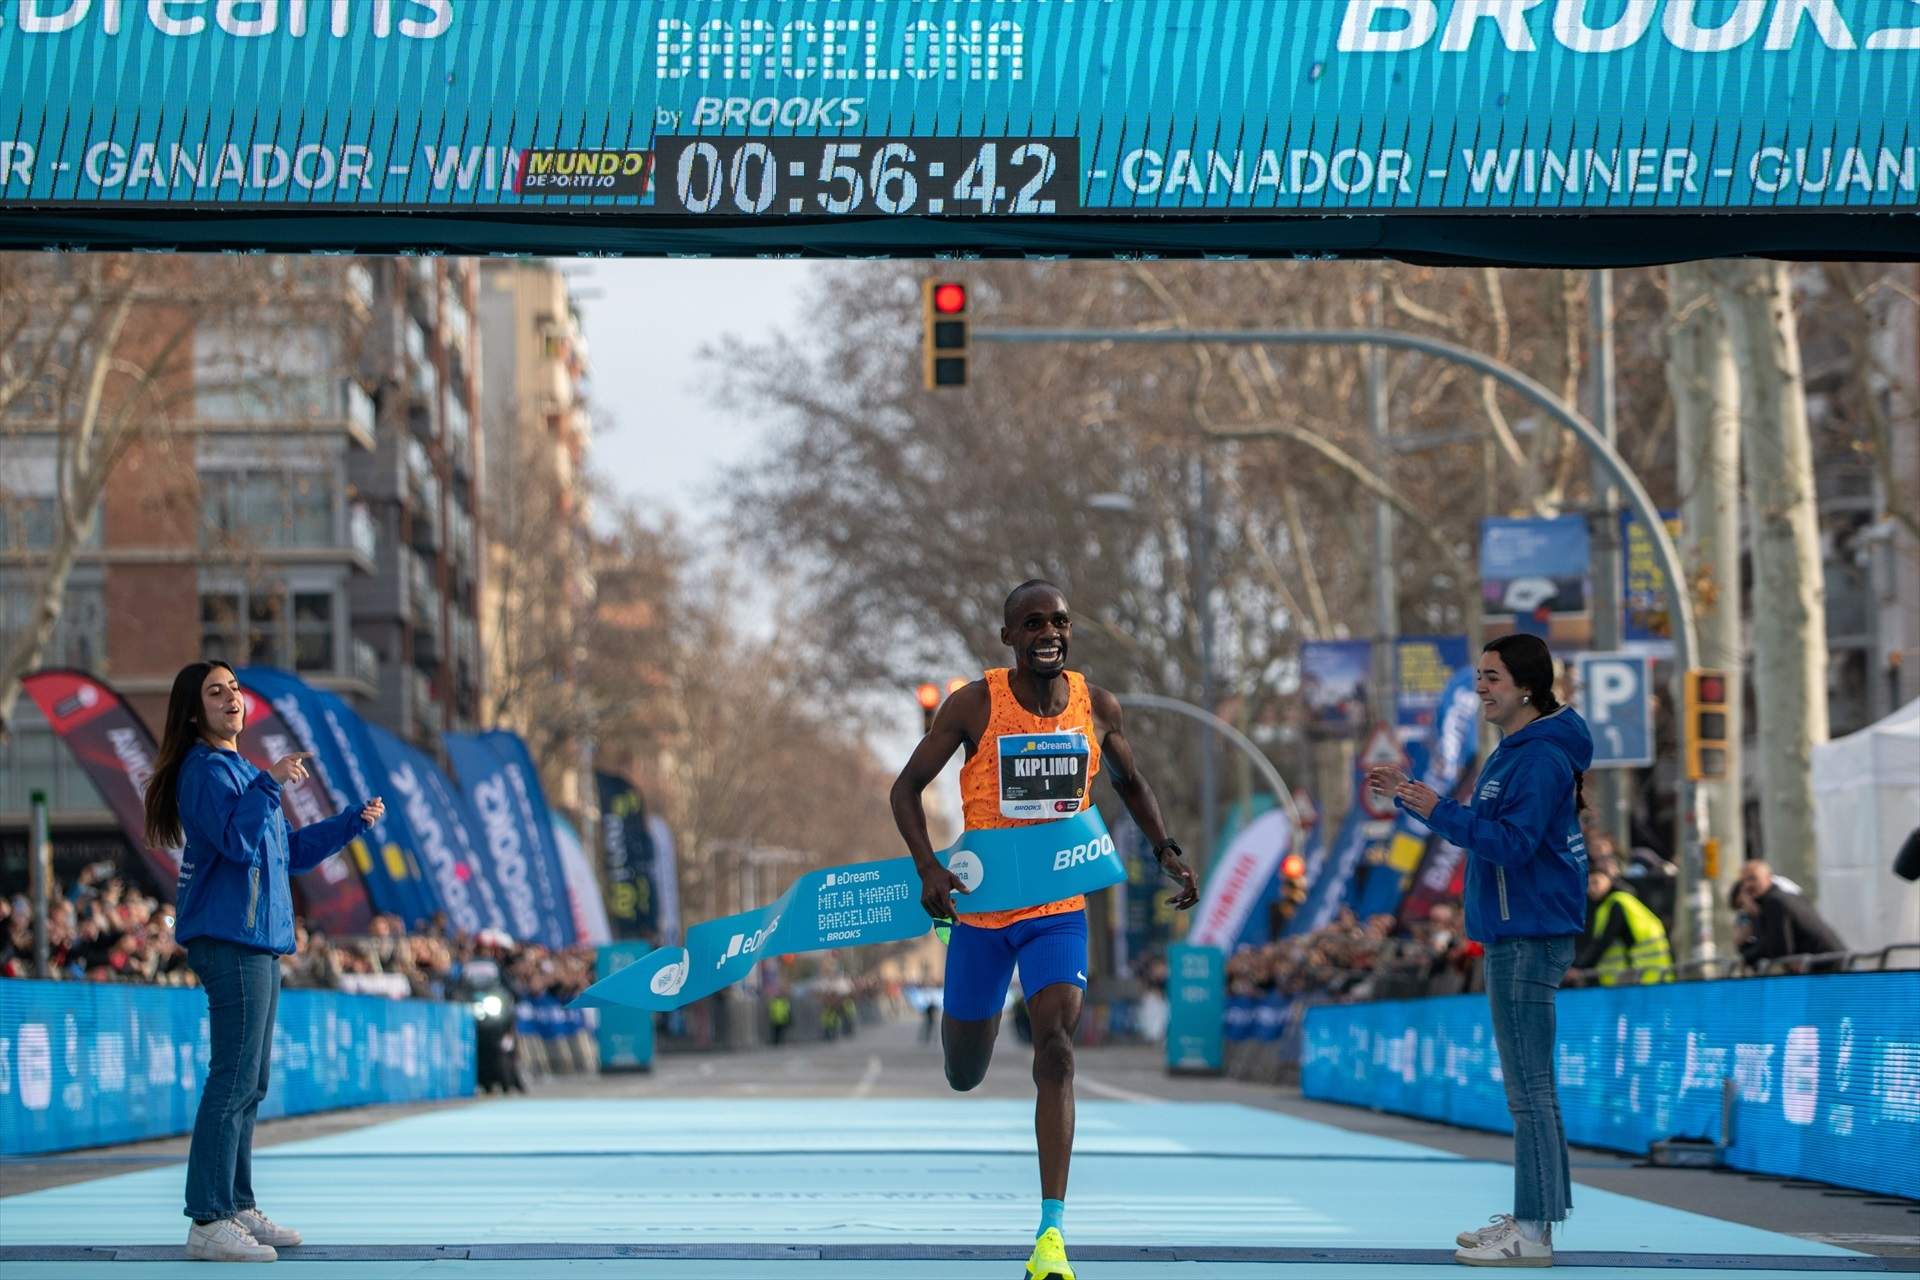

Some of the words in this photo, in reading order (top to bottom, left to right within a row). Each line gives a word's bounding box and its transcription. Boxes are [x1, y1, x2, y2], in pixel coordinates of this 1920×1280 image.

[1337, 0, 1920, 52] BROOK
[656, 18, 1024, 80] BARCELONA
[656, 105, 682, 129] by
[692, 97, 865, 127] BROOKS
[85, 141, 374, 190] GANADOR
[528, 152, 643, 175] MUNDO
[1121, 148, 1413, 195] GANADOR
[1462, 147, 1698, 195] WINNER
[1750, 146, 1920, 193] GUAN
[677, 142, 1056, 214] 00:56:42
[1590, 662, 1638, 724] P
[1036, 741, 1072, 751] eDreams
[1014, 757, 1079, 777] KIPLIMO
[1044, 779, 1050, 790] 1
[1053, 833, 1115, 871] BROO
[837, 870, 881, 886] eDreams
[818, 890, 855, 911] MITJA
[818, 906, 892, 931] BARCELONA
[826, 929, 862, 942] BROOKS
